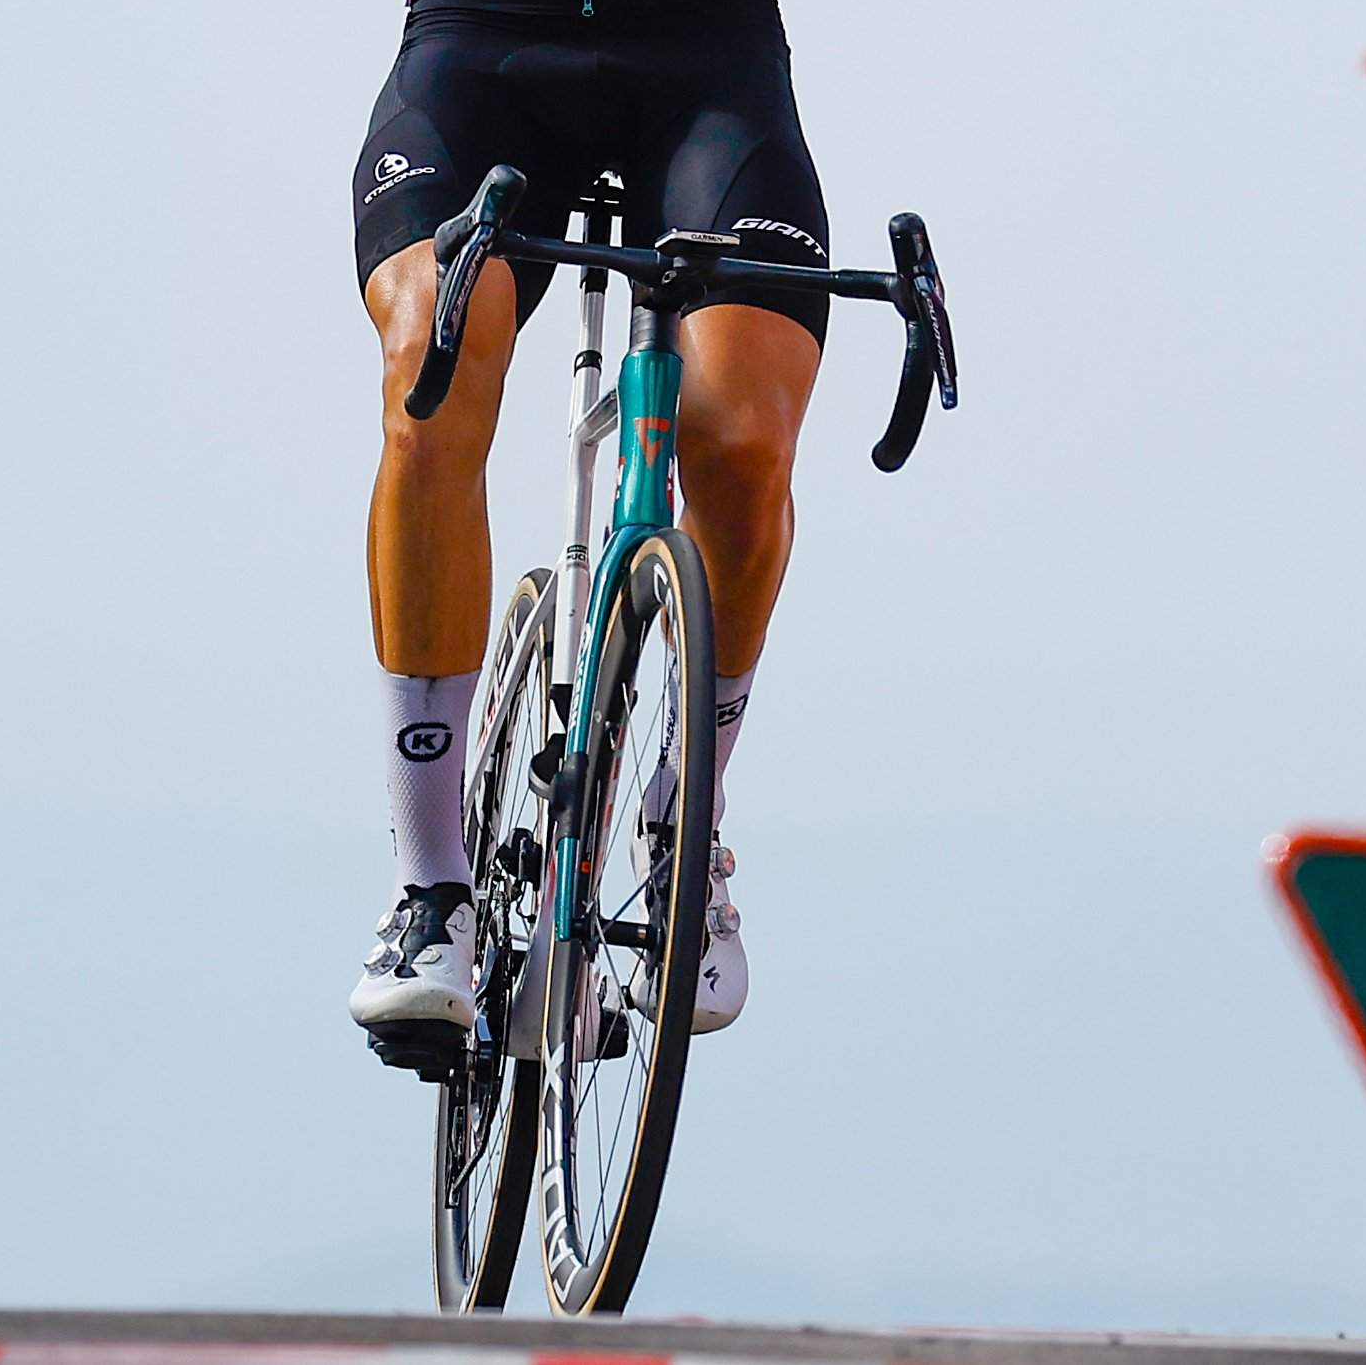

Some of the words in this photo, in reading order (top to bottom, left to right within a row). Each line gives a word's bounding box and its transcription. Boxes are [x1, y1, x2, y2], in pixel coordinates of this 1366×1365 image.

[364, 167, 435, 204] ETXEONDO
[690, 233, 723, 243] GARMIN
[731, 218, 827, 259] GIANT
[542, 1040, 582, 1303] CADEX
